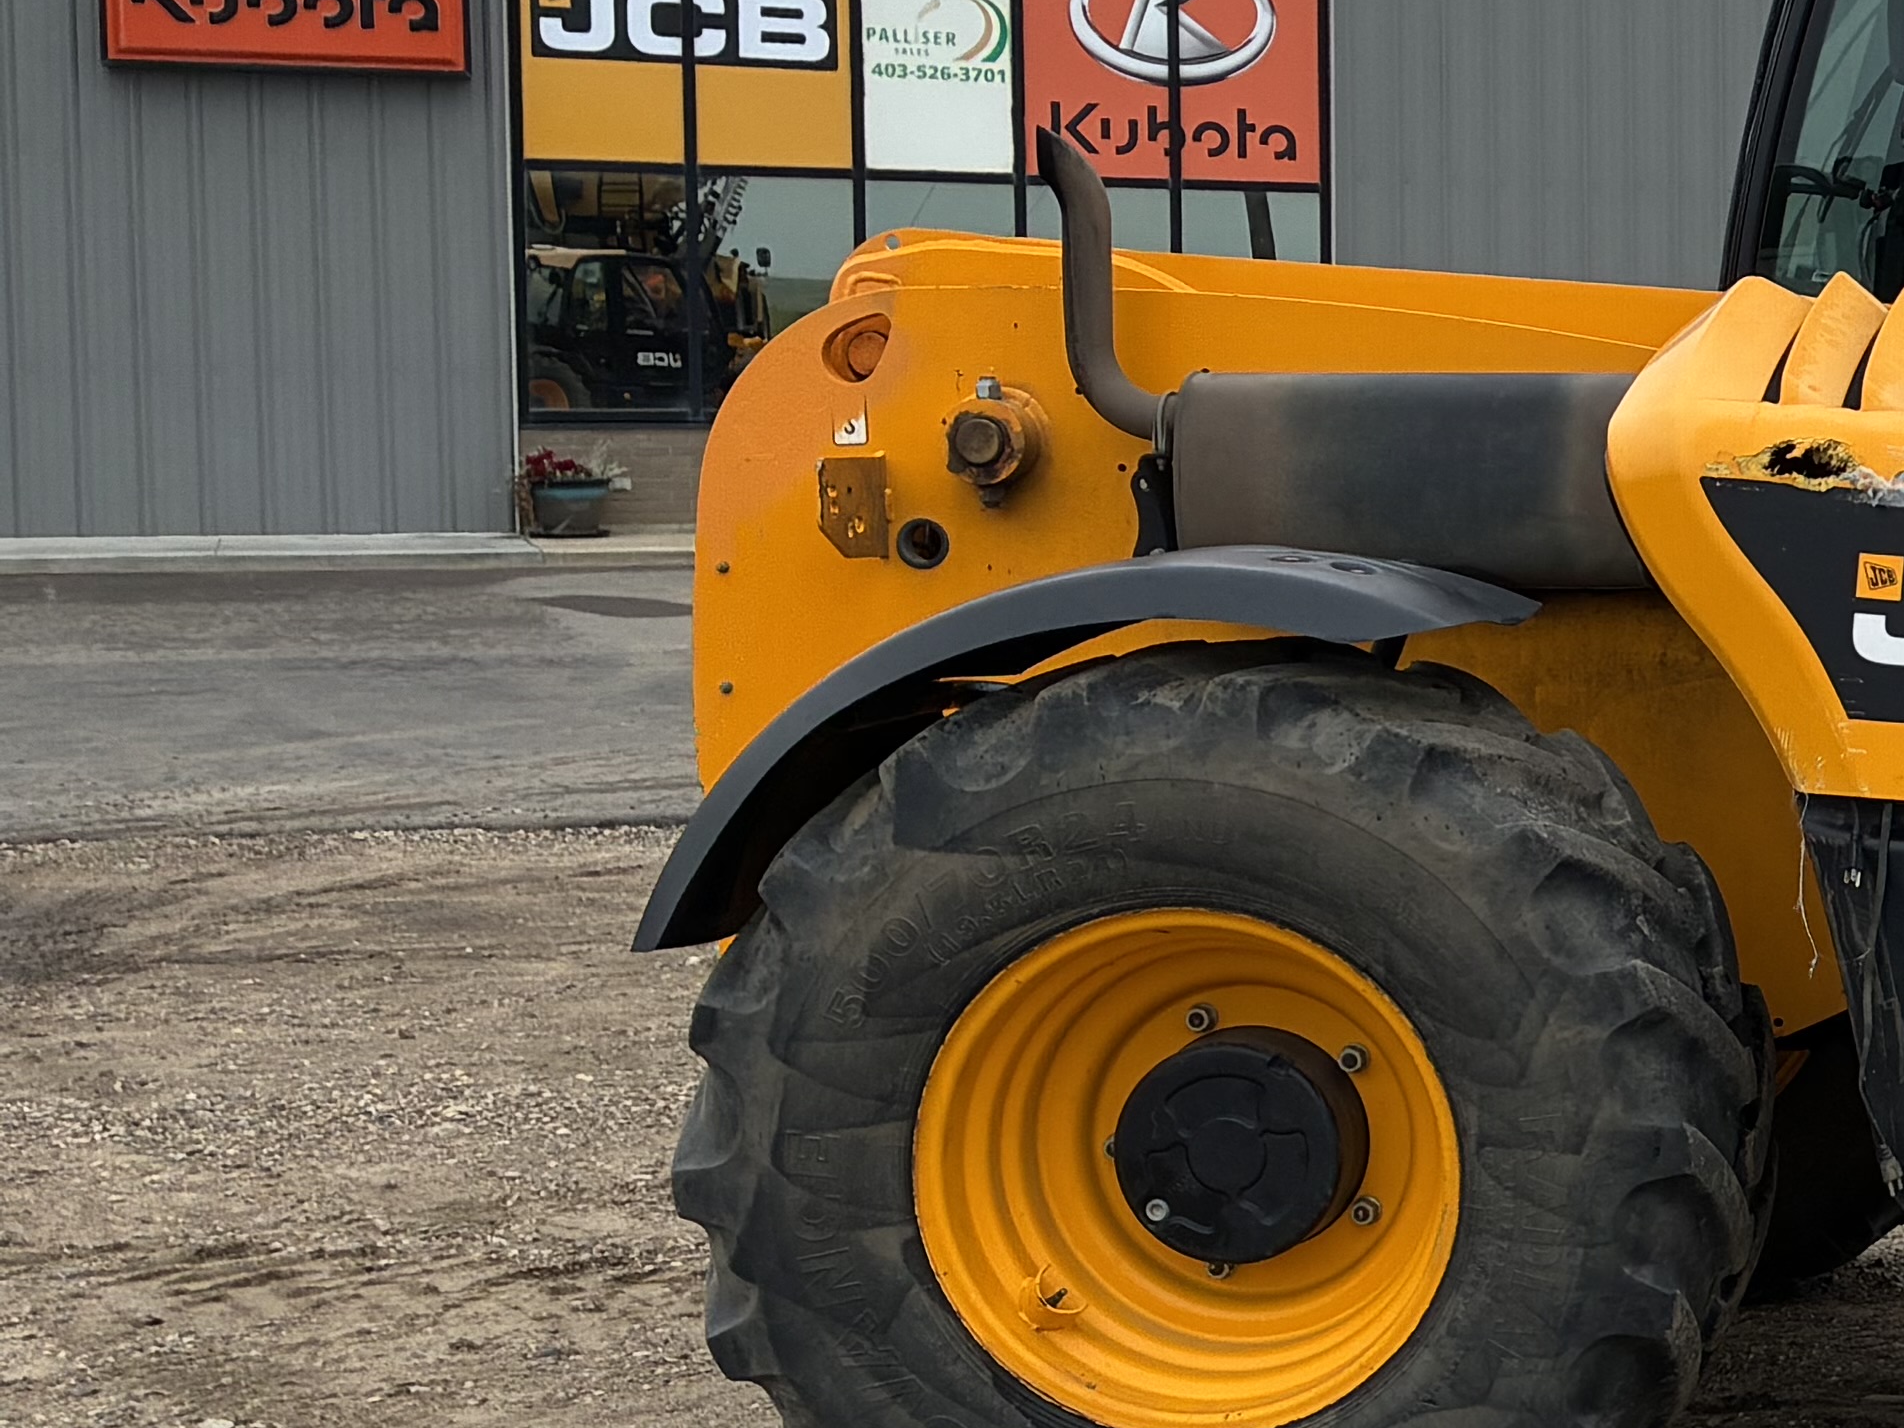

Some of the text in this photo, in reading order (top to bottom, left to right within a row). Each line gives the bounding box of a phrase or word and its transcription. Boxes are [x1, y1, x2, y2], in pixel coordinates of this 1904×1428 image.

[866, 26, 957, 47] PALLISER
[894, 47, 930, 57] SALES
[871, 62, 1006, 83] 403-526-3701
[1050, 101, 1297, 161] Kubota
[1870, 565, 1896, 586] JCB
